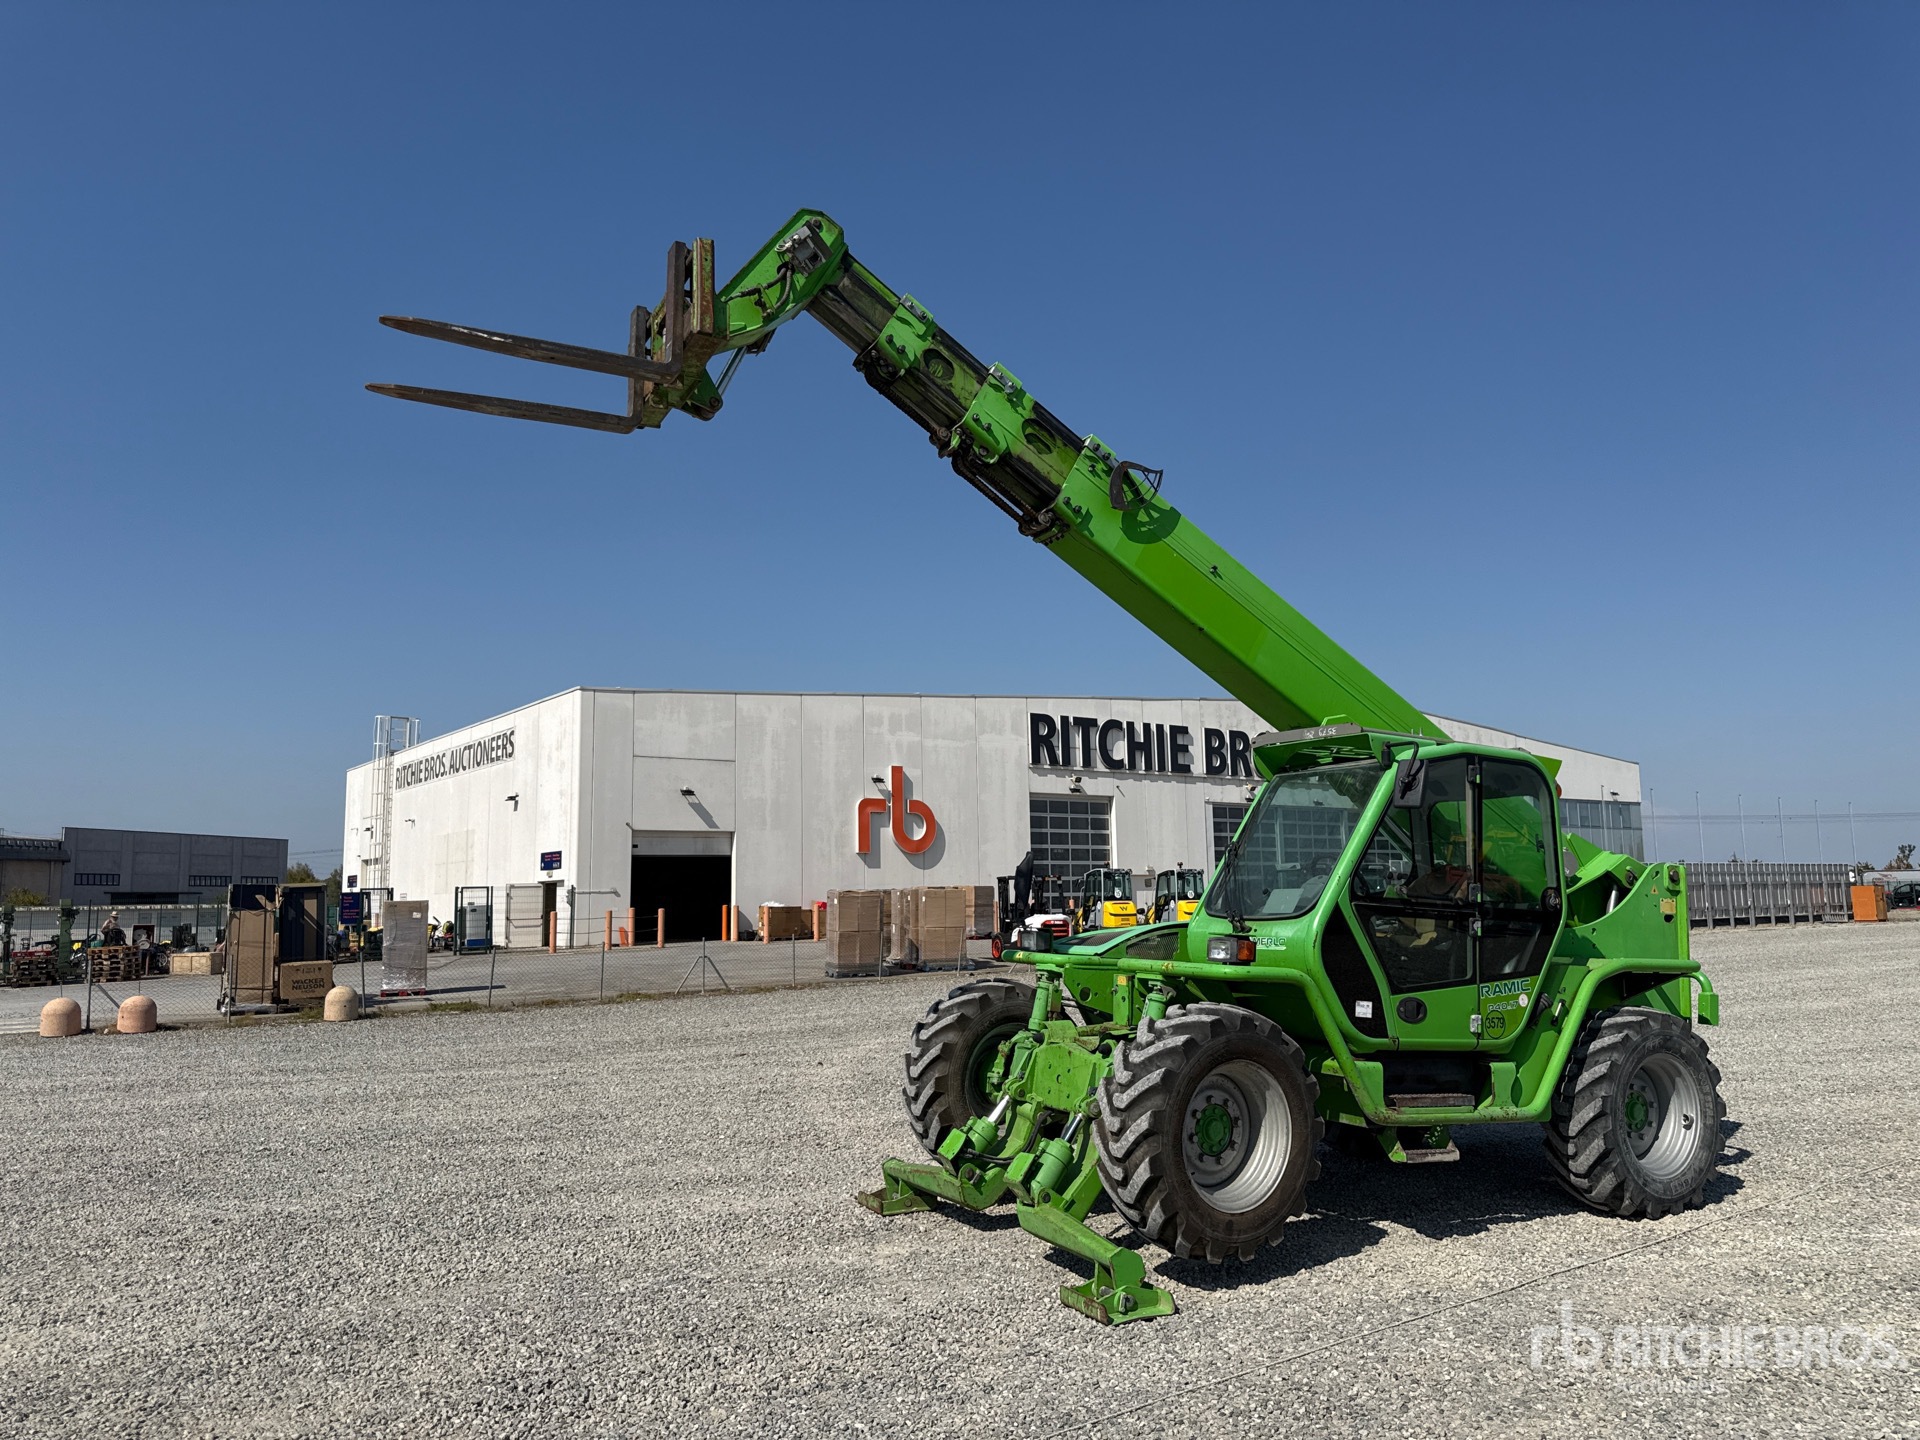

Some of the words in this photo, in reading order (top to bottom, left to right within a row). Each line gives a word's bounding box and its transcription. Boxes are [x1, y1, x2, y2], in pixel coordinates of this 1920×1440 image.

[396, 760, 423, 790] RITCHIE
[424, 752, 447, 782] BROS.
[448, 730, 515, 776] AUCTIONEERS
[1029, 712, 1192, 773] RITCHIE
[1202, 727, 1264, 778] BR
[857, 765, 937, 855] rb
[1480, 978, 1531, 999] RAMIC
[1486, 1017, 1504, 1029] 3579
